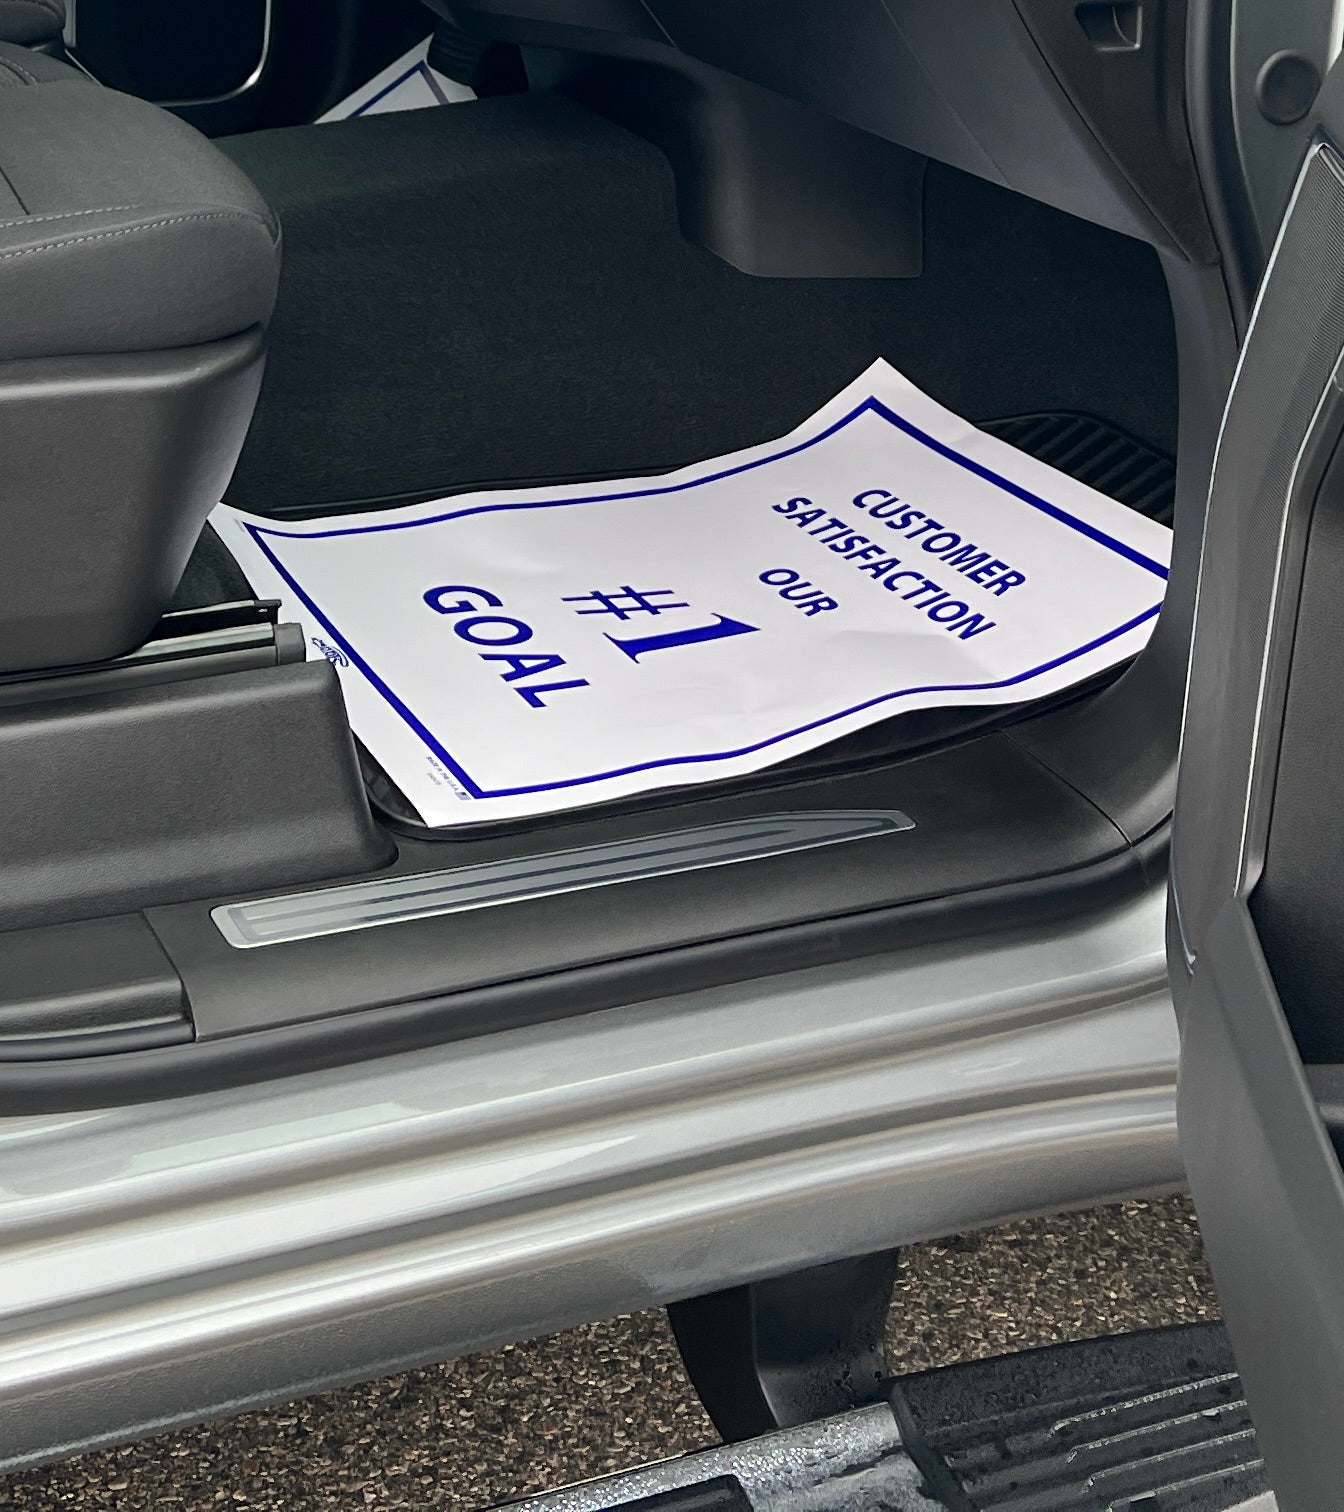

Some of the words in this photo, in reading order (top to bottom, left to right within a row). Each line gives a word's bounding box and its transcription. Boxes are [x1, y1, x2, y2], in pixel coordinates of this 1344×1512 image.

[758, 568, 839, 617] OUR
[771, 496, 997, 640] SATISFACTION
[852, 488, 1026, 597] CUSTOMER
[423, 585, 591, 708] GOAL
[560, 585, 762, 664] #1
